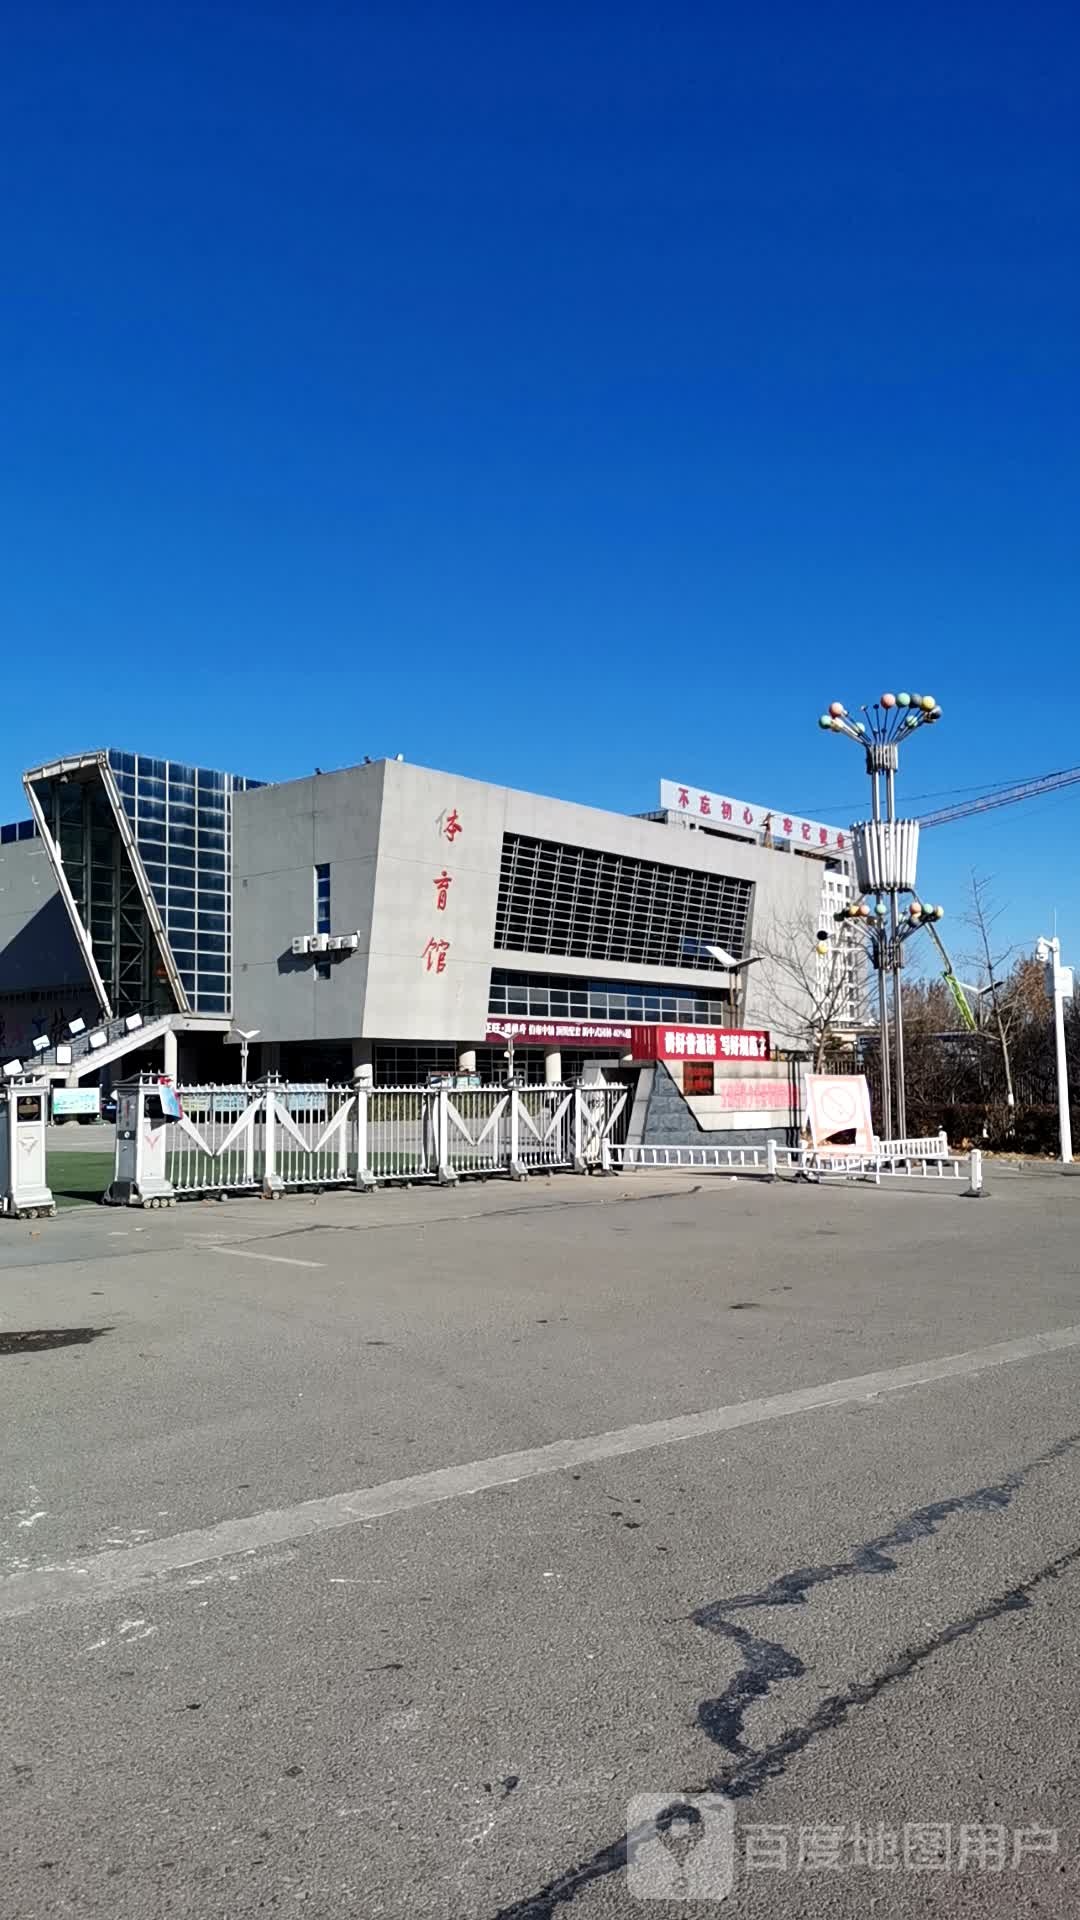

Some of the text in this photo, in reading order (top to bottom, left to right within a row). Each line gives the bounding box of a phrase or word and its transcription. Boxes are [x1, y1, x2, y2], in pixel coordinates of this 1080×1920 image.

[678, 787, 754, 825] 不忘初心
[422, 808, 463, 974] 体育馆
